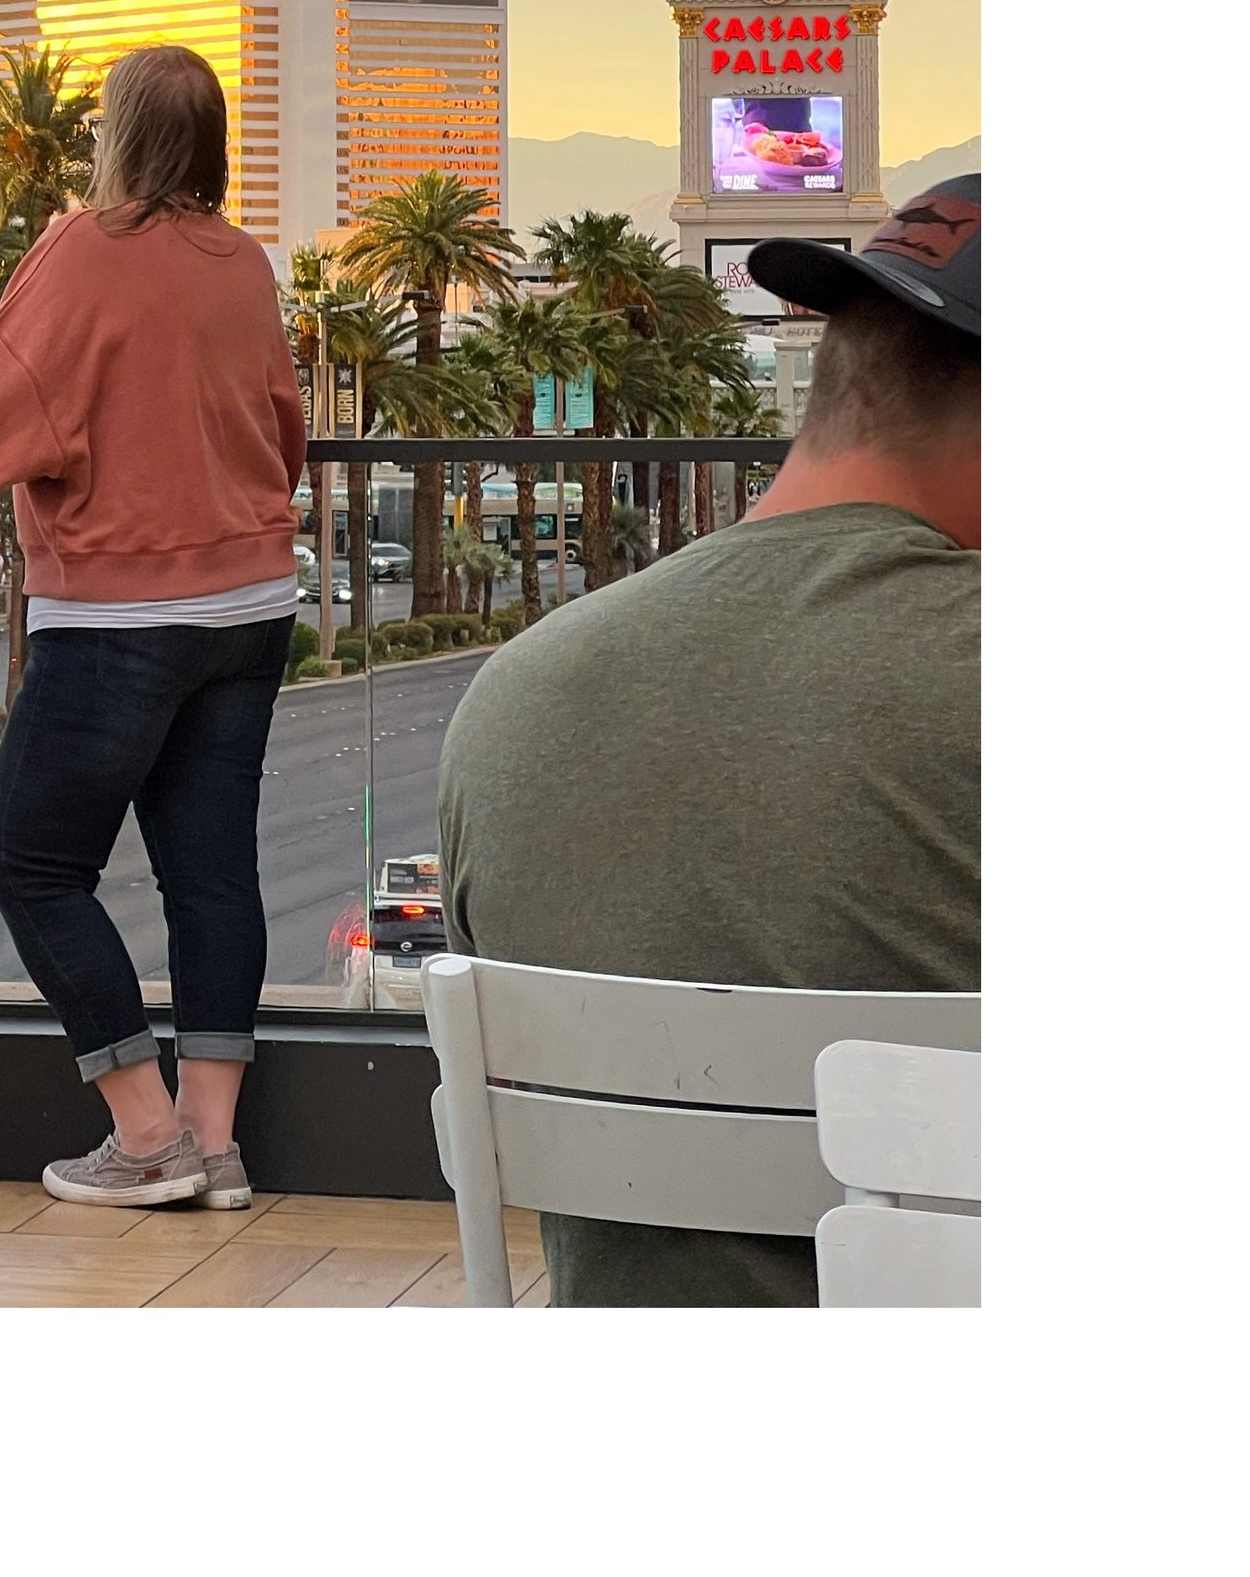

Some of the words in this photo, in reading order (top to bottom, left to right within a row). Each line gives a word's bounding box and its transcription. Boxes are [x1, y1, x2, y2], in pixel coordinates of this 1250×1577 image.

[702, 14, 853, 43] CAESARS
[711, 47, 845, 75] PALACE
[727, 262, 749, 276] RO
[336, 389, 354, 424] BORN
